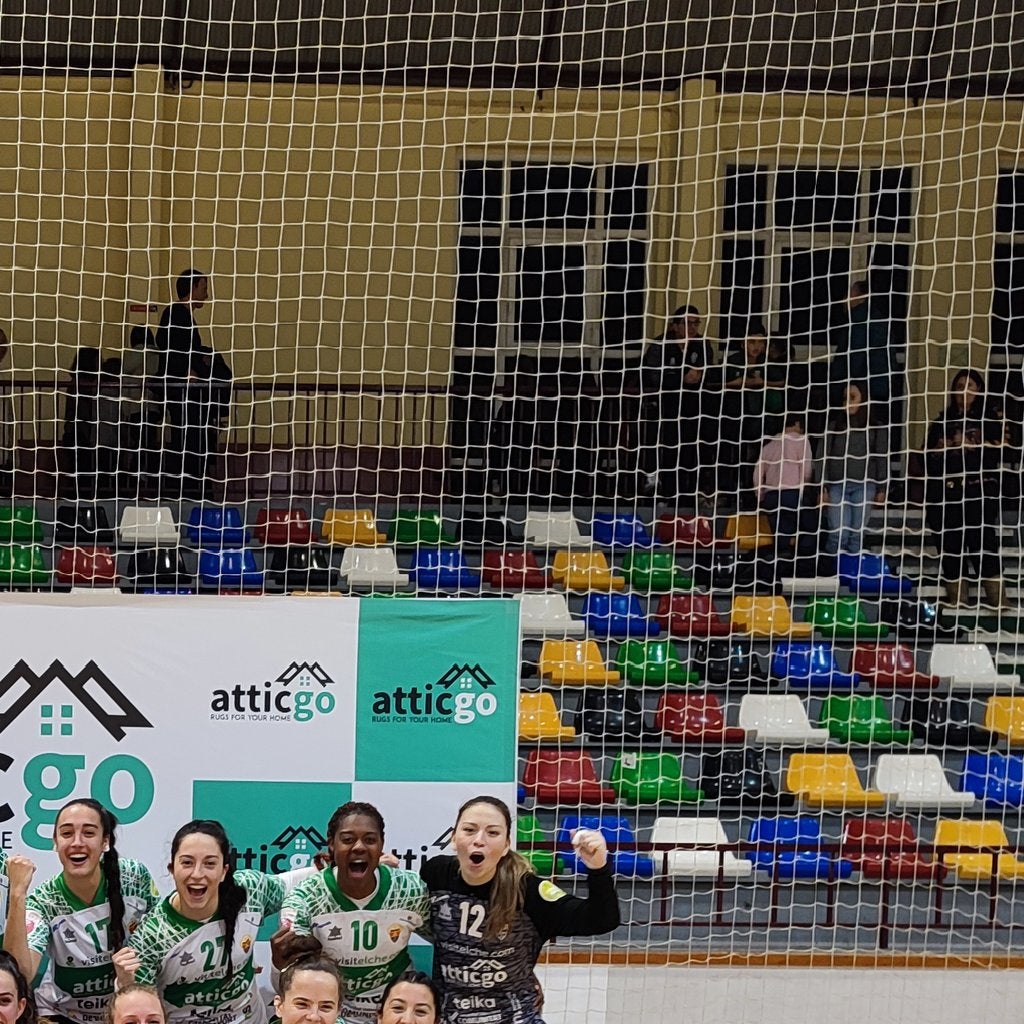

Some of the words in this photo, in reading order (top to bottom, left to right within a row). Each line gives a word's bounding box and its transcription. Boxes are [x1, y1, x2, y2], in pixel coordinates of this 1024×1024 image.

[211, 681, 336, 723] atticgo
[372, 684, 497, 724] atticgo
[84, 917, 112, 954] 17
[350, 919, 378, 951] 10
[459, 901, 486, 938] 12
[200, 936, 227, 972] 27
[336, 952, 397, 966] visitelche.c
[73, 971, 115, 995] atti
[77, 999, 109, 1010] teik
[452, 995, 497, 1010] teika
